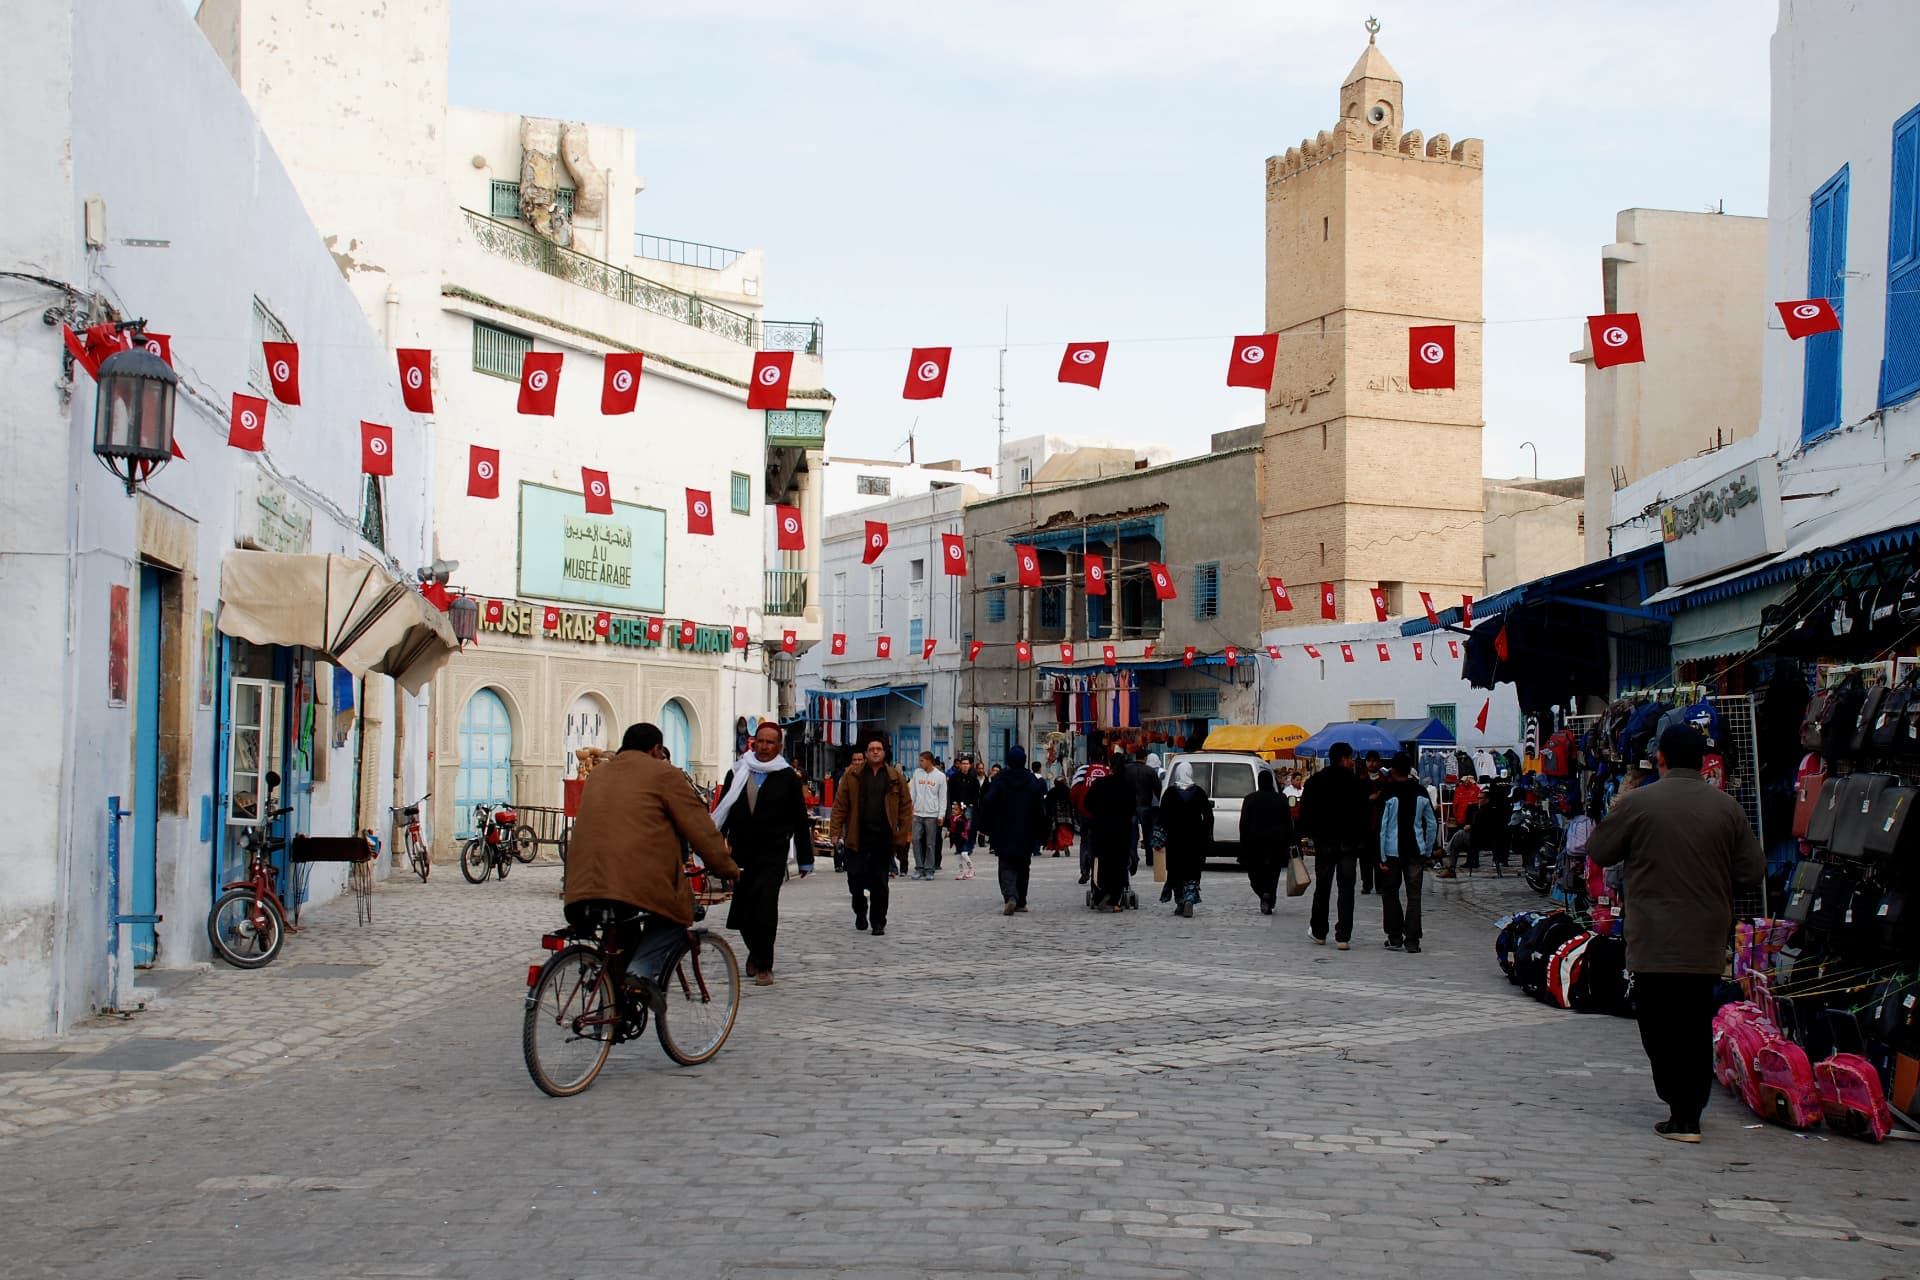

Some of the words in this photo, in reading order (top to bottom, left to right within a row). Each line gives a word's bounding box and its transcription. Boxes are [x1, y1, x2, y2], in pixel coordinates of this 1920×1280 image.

[592, 544, 607, 562] AU
[563, 556, 599, 582] MUSEE
[599, 562, 632, 587] ARABE
